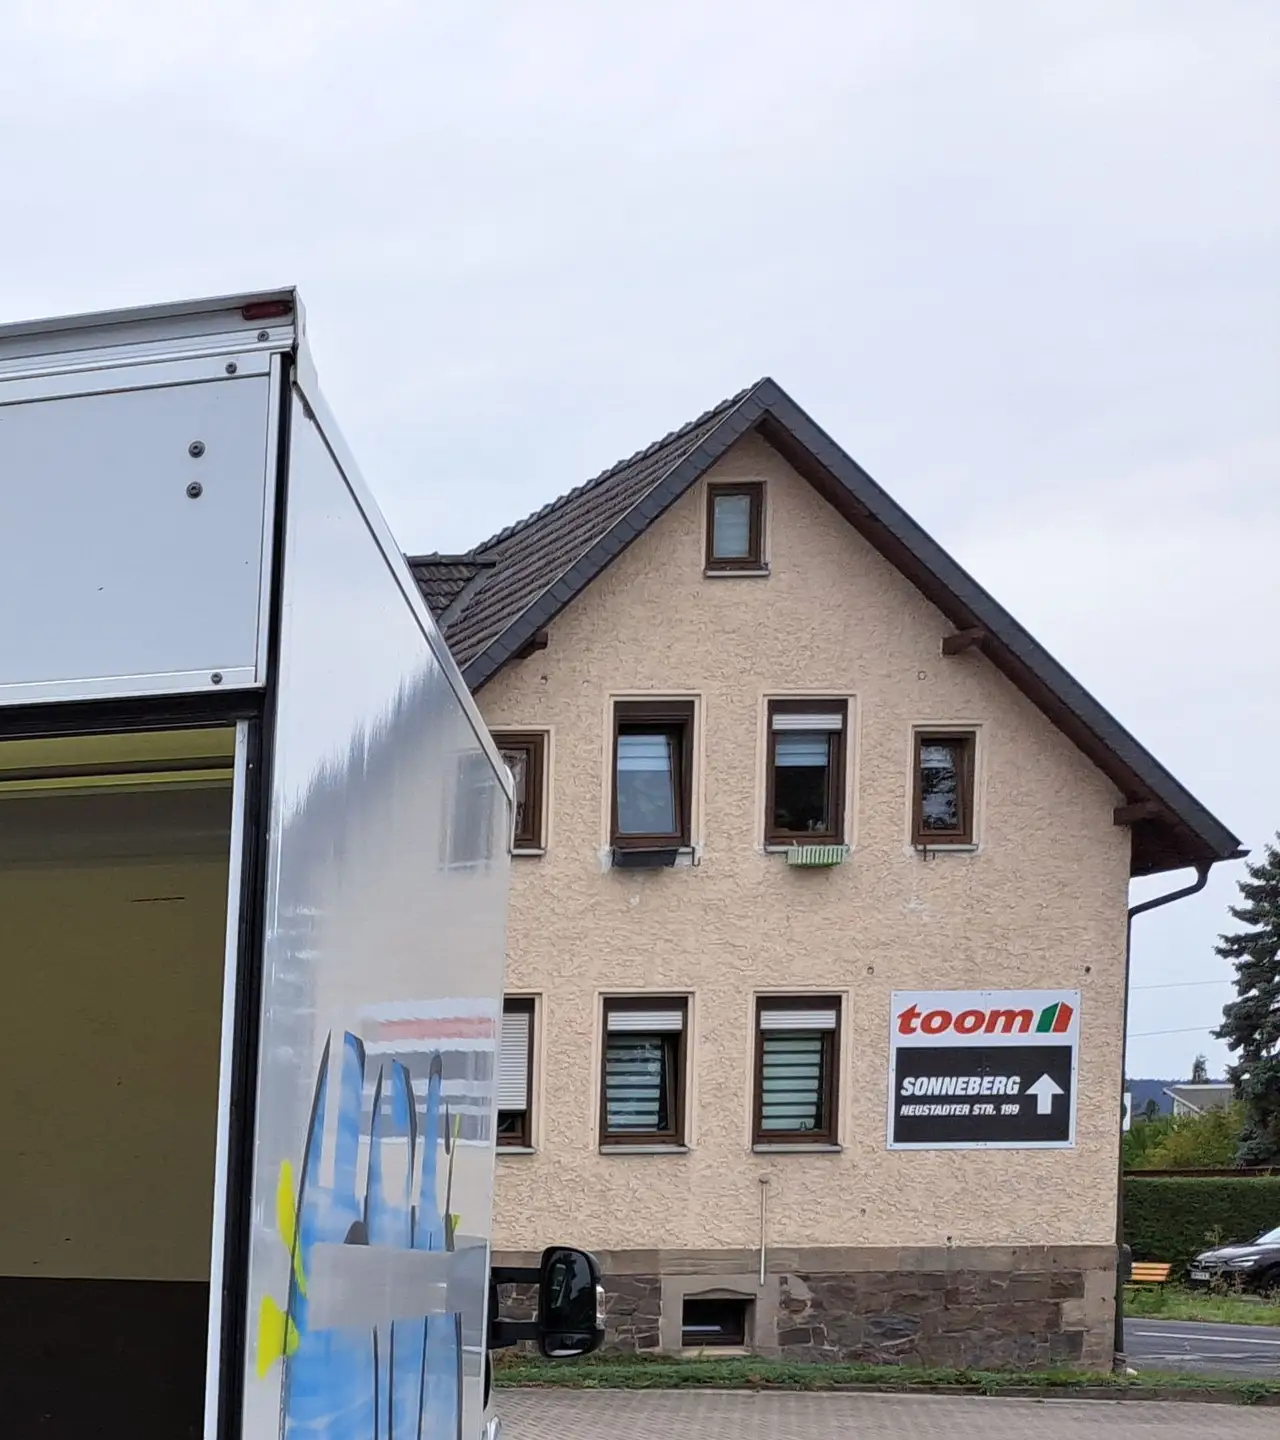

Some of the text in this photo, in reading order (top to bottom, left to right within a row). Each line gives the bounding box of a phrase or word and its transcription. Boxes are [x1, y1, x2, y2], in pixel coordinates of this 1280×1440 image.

[897, 1003, 1034, 1035] toom
[900, 1075, 1021, 1096] SONNEBERG
[972, 1104, 996, 1115] STR.
[1000, 1104, 1020, 1115] 199
